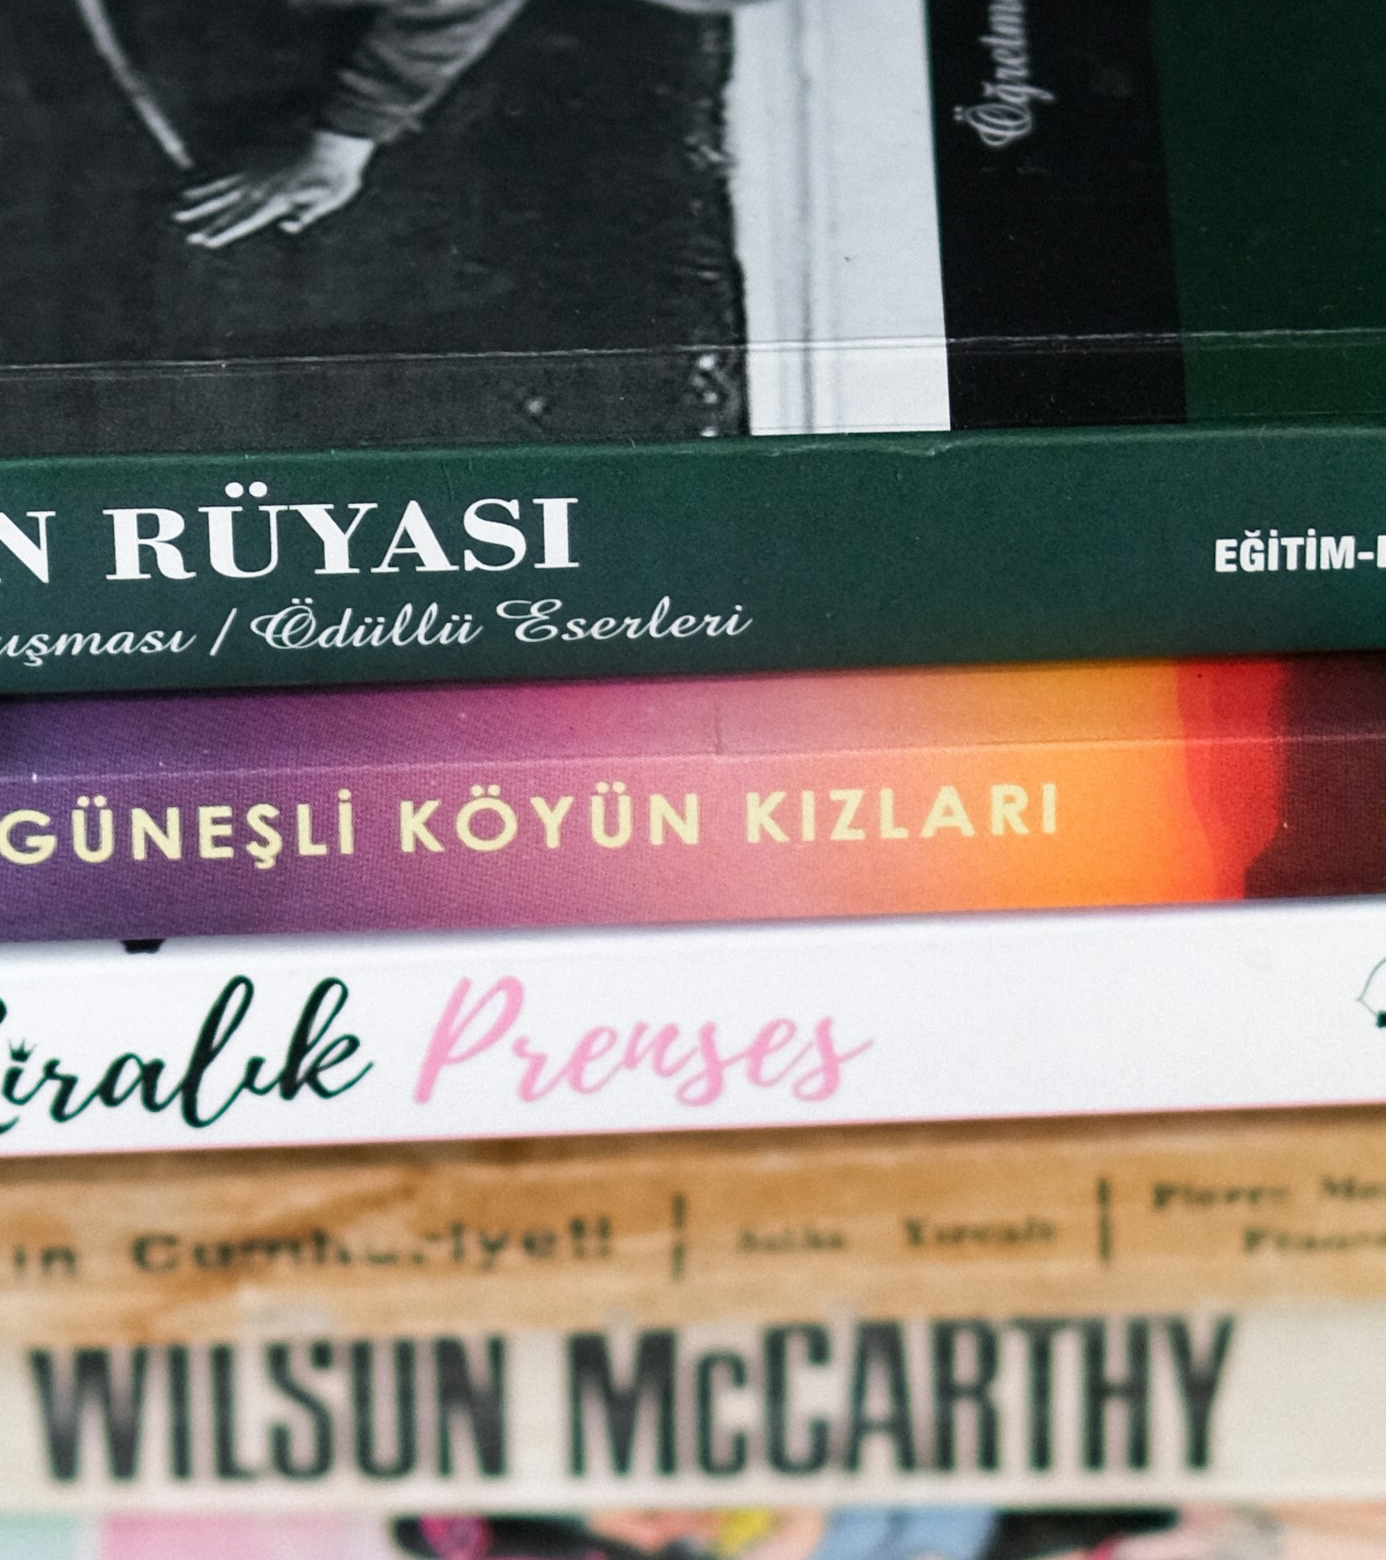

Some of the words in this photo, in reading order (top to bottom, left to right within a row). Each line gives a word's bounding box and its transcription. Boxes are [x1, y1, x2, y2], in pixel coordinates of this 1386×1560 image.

[102, 480, 582, 583] RÜYASI
[248, 597, 483, 651] Ödüllü
[494, 594, 755, 643] Eserleri
[399, 779, 700, 853] KÖYÜN
[743, 782, 1061, 842] KIZLARI
[413, 974, 875, 1109] Prenses
[566, 1313, 1237, 1480] McCARTHY
